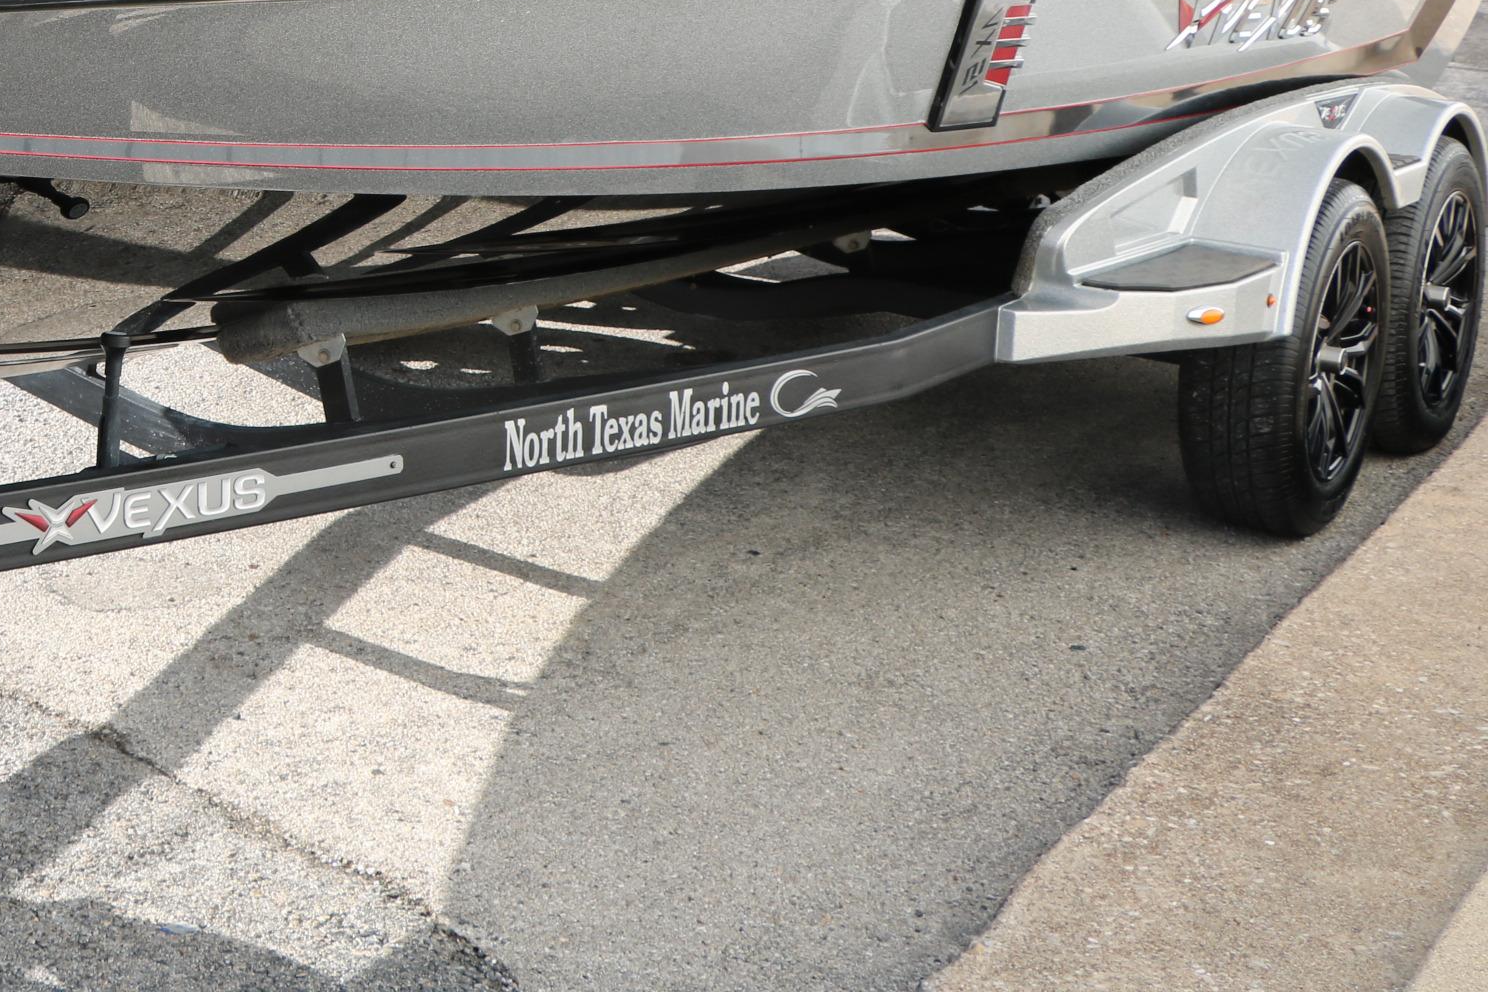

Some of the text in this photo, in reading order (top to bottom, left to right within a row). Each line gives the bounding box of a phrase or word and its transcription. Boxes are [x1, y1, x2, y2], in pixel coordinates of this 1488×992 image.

[503, 381, 760, 471] North Texas Marine
[82, 474, 266, 535] VEXUS
